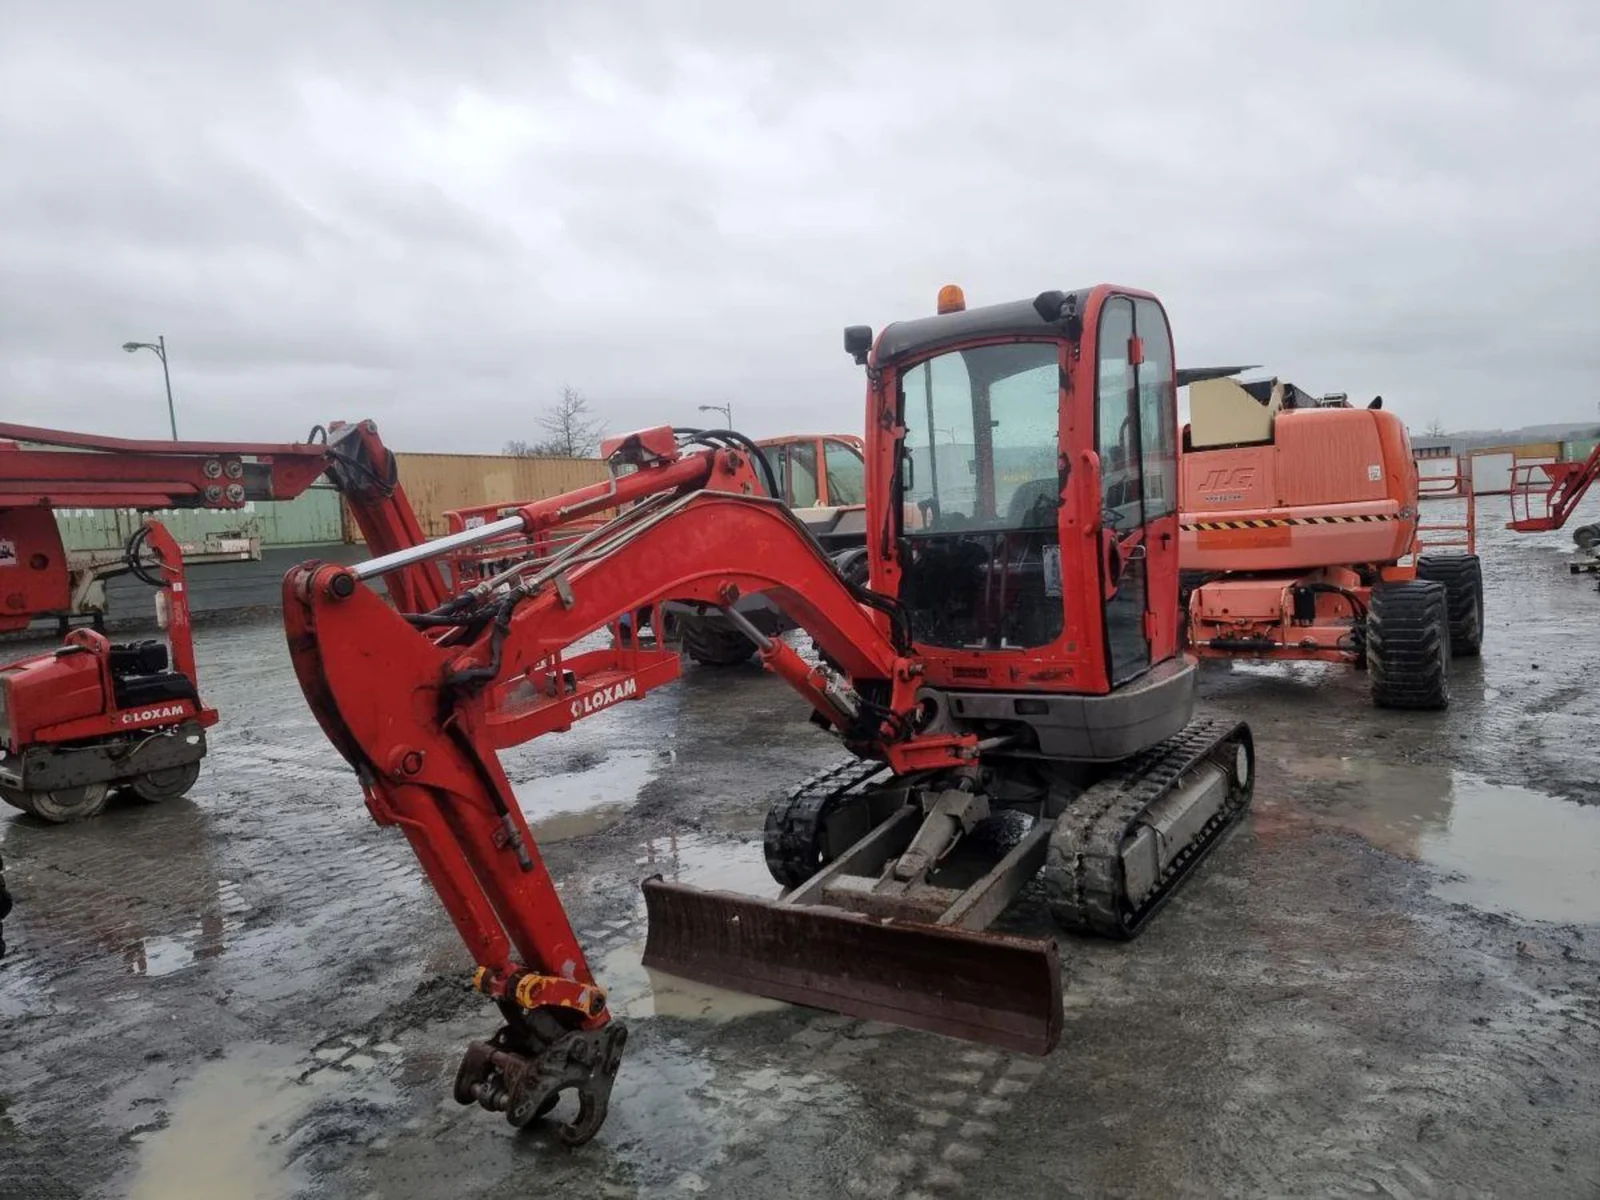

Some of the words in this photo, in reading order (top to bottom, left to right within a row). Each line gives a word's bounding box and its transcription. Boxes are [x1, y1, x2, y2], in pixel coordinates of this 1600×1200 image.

[1197, 467, 1255, 492] JLG
[584, 678, 637, 712] LOXAM
[133, 704, 184, 722] LOXAM
